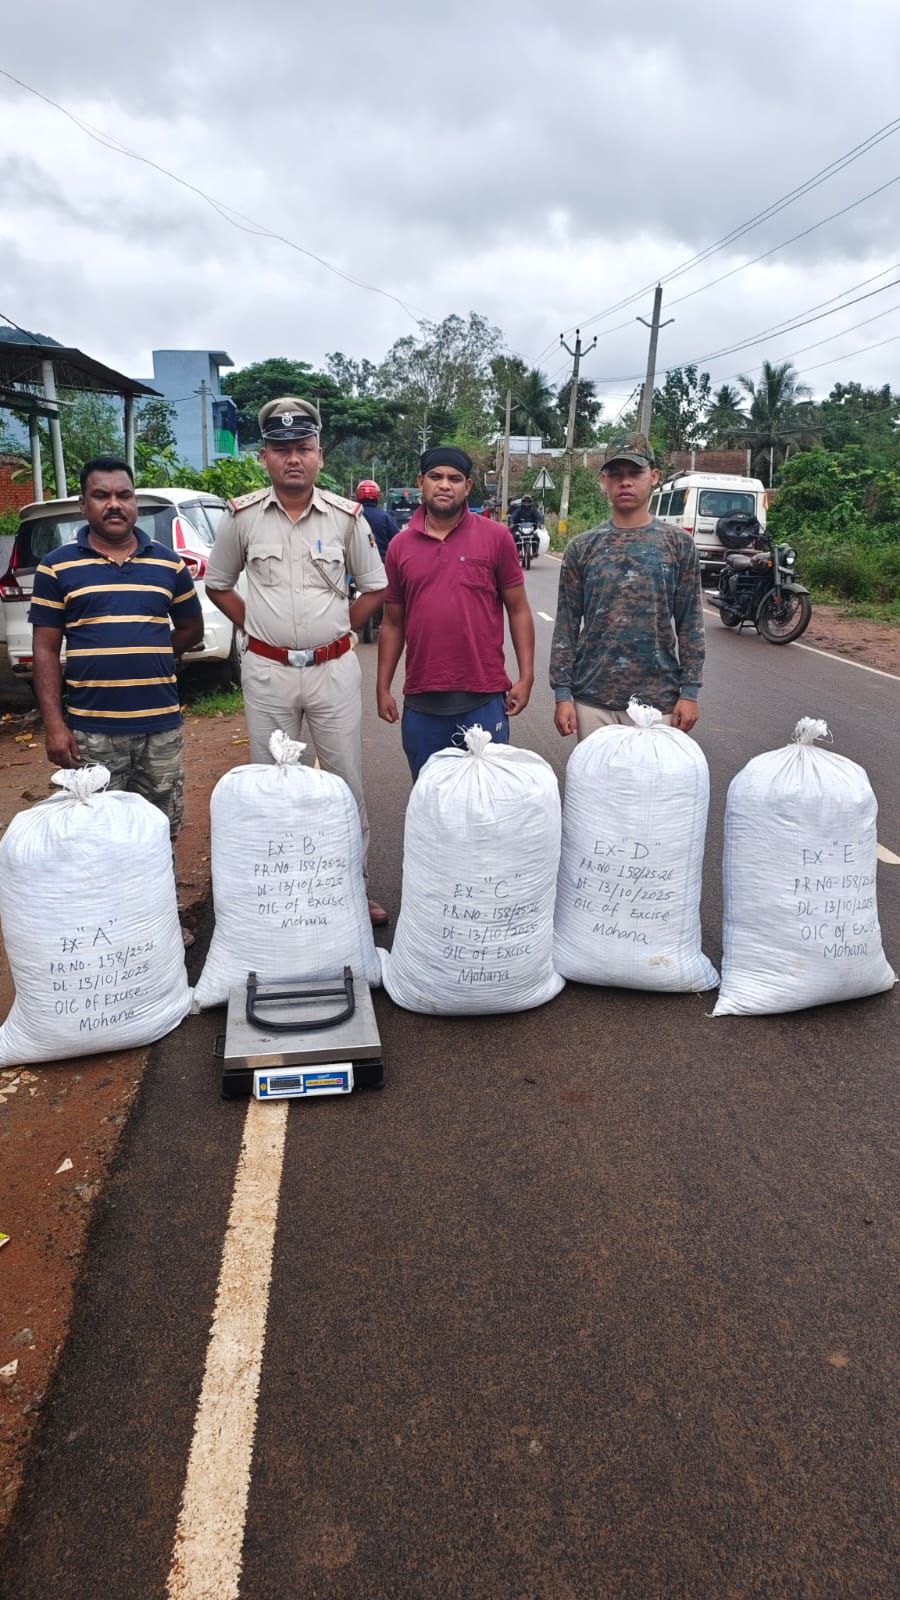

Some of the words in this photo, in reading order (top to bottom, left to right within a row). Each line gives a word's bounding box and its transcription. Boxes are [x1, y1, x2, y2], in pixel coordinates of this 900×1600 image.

[598, 881, 675, 904] 13/10/2025
[258, 902, 279, 915] OIC
[574, 898, 595, 912] OIC
[601, 902, 620, 918] of
[630, 908, 670, 921] Excise
[801, 923, 828, 941] OIC
[443, 946, 466, 960] OIC
[824, 940, 868, 958] Mohana
[55, 1000, 79, 1014] OIC
[79, 1009, 135, 1031] Mohana
